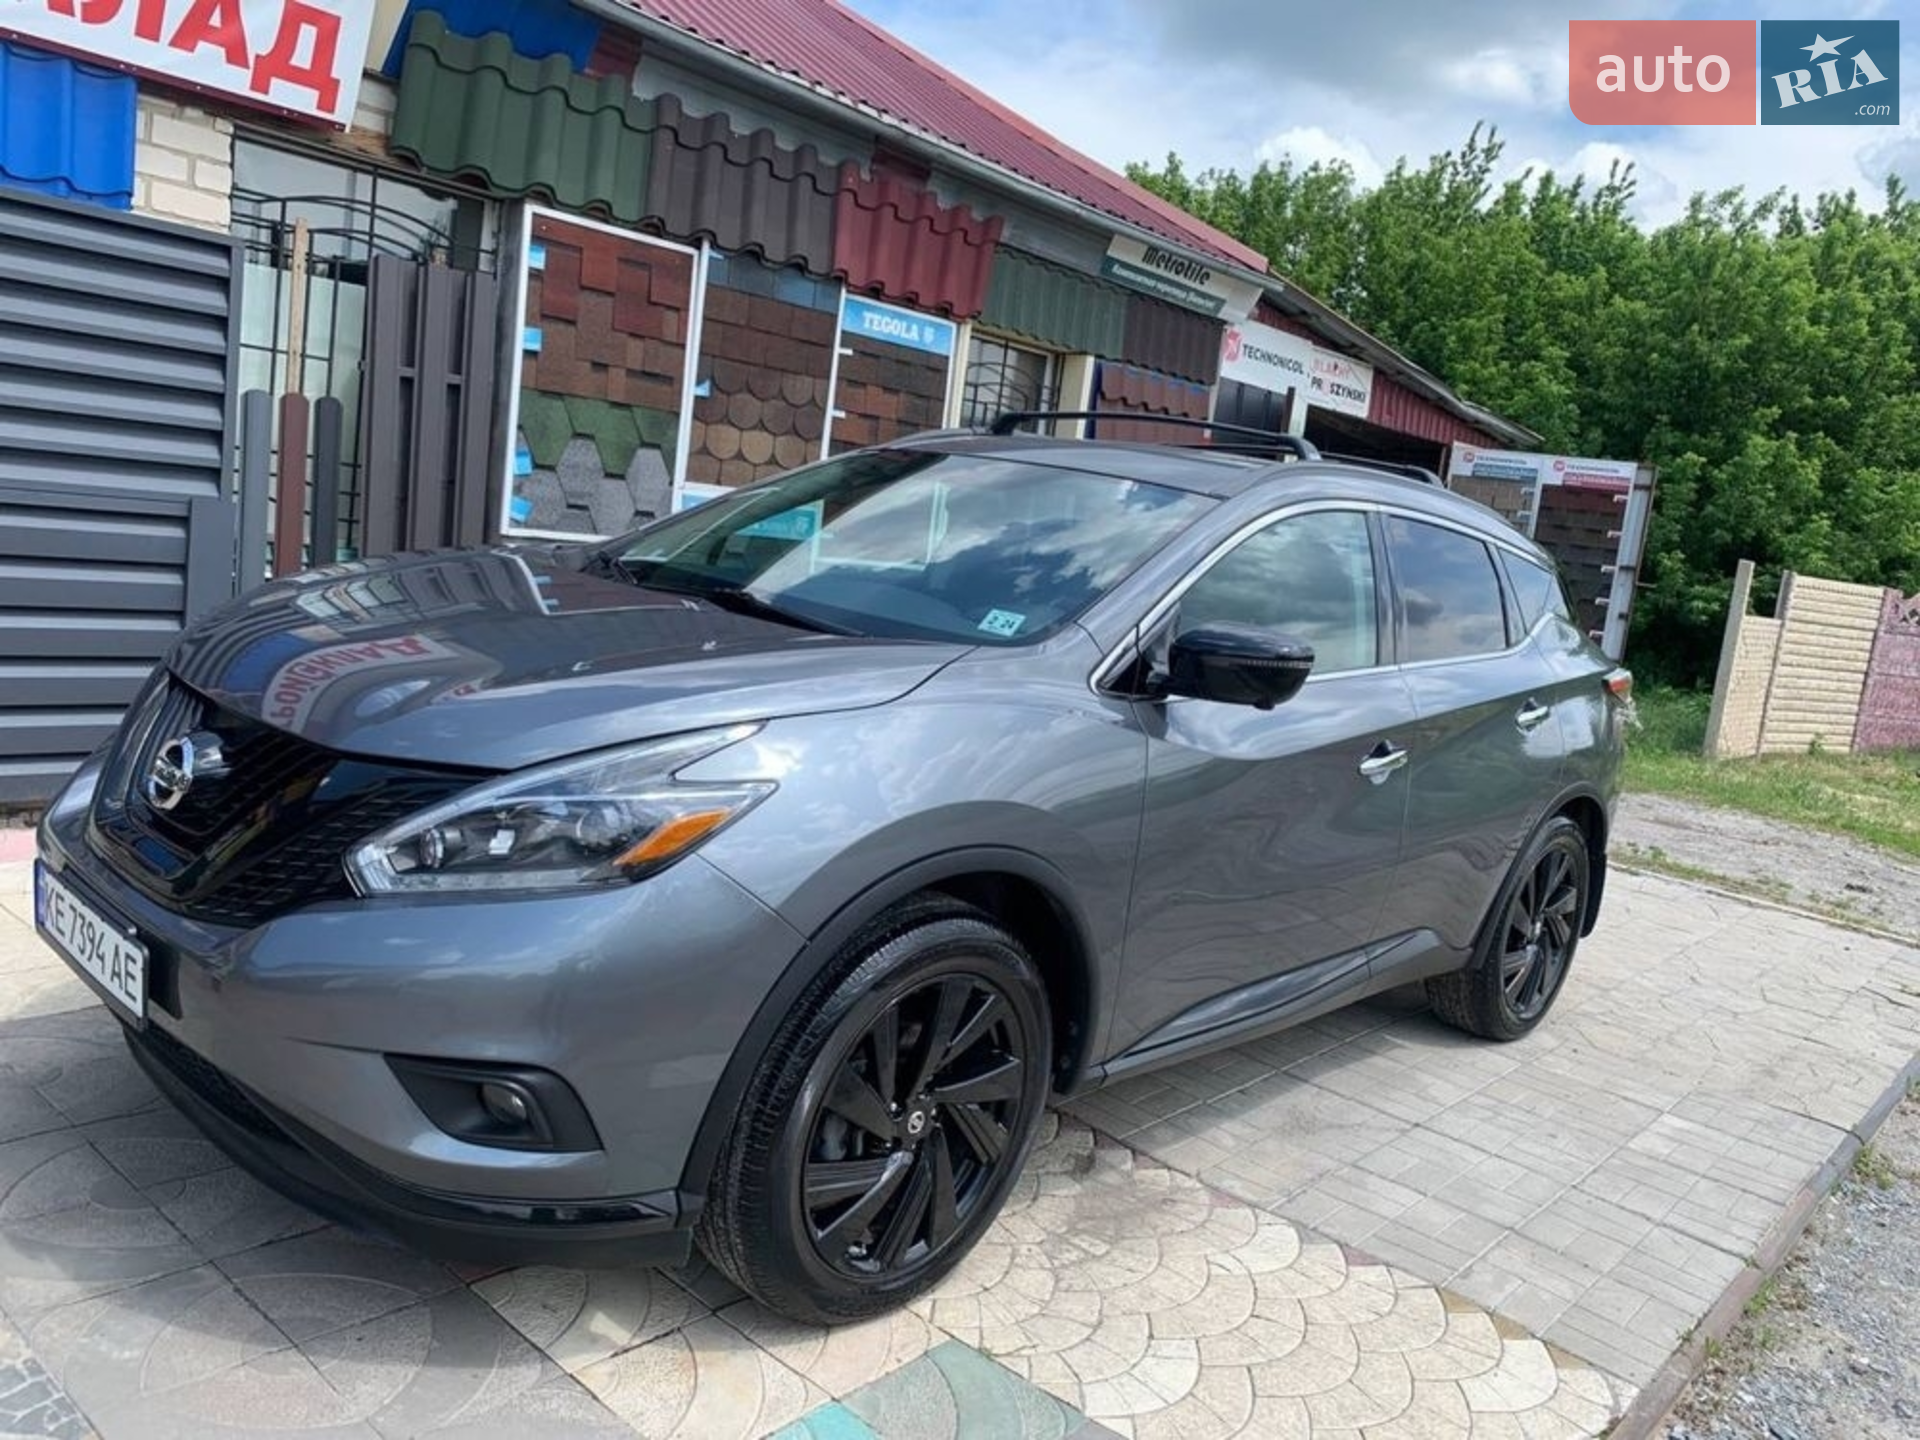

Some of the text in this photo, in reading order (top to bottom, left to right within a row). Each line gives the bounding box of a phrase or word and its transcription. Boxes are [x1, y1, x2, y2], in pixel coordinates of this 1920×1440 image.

[862, 310, 920, 341] TEGOLA
[1242, 343, 1304, 375] TECHNONICOL
[69, 904, 106, 975] 7394
[110, 944, 138, 1004] AE
